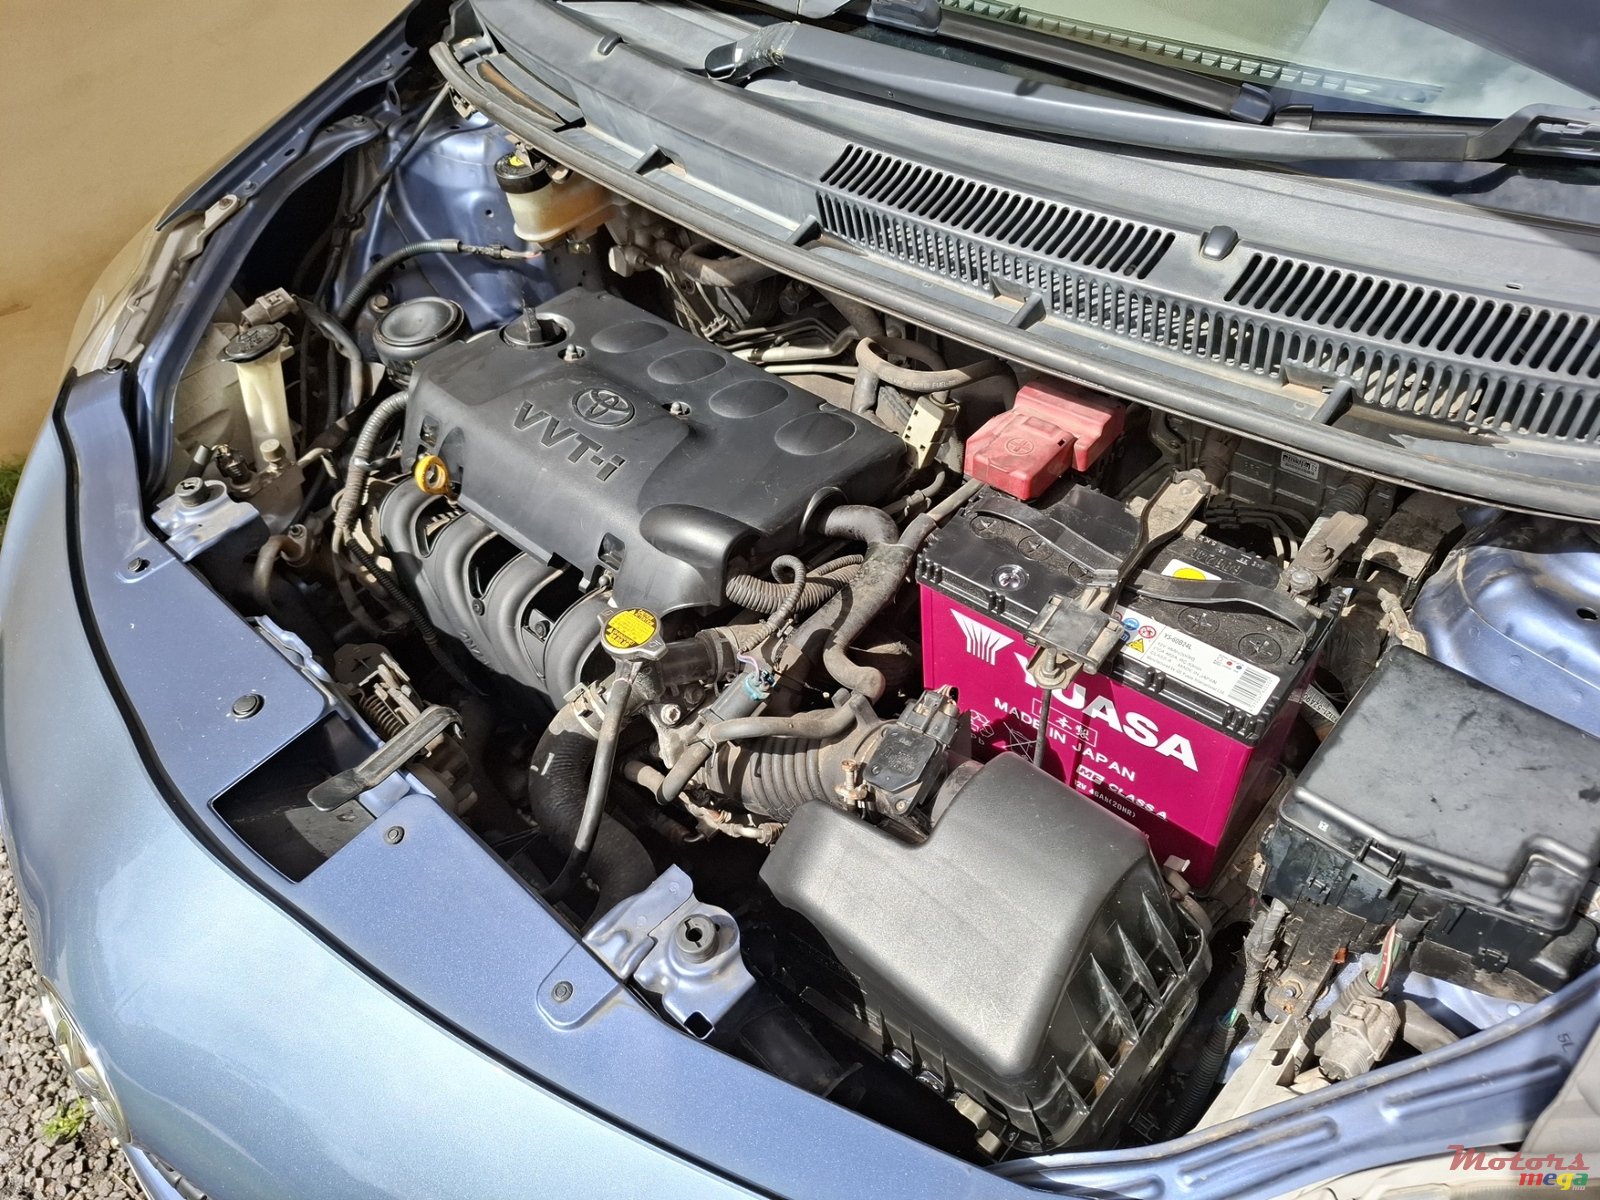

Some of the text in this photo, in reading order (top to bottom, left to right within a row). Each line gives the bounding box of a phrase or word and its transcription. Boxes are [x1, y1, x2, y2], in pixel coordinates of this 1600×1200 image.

[513, 400, 625, 481] VVT-i
[994, 697, 1136, 782] MADE IN JAPAN
[1038, 704, 1090, 741] 本製
[1108, 783, 1155, 813] CLASS
[1156, 811, 1168, 820] A
